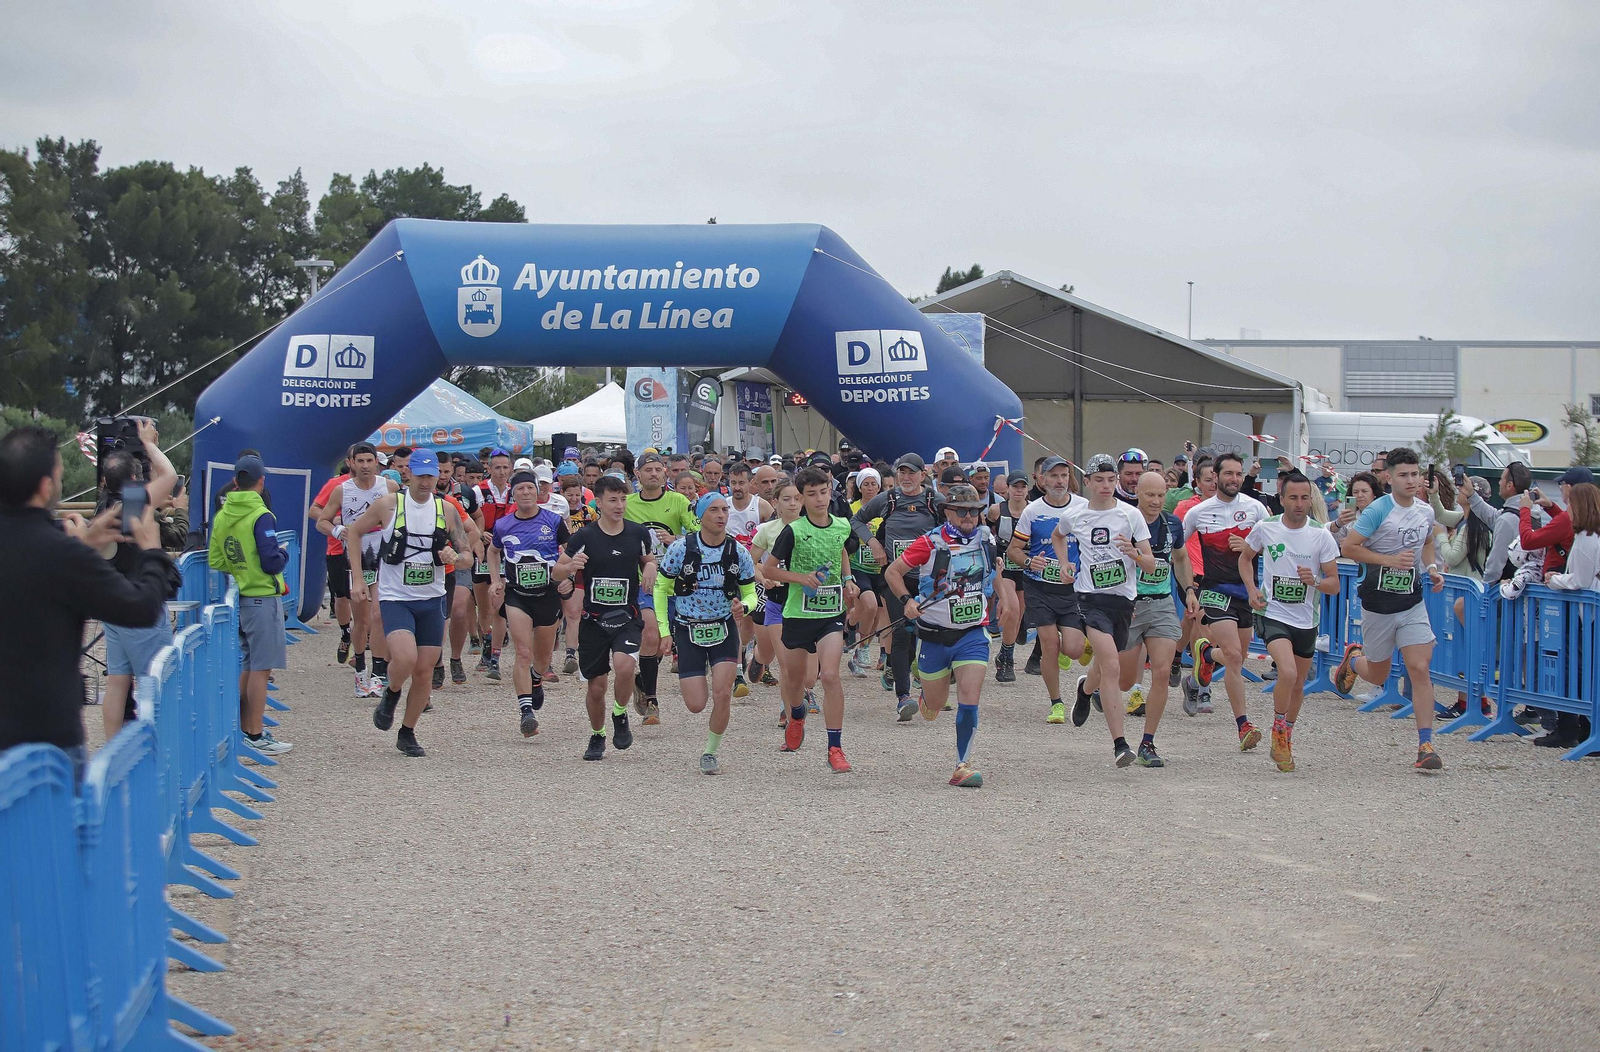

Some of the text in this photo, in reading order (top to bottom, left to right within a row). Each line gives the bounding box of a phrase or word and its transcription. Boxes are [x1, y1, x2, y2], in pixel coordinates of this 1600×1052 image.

[513, 261, 760, 298] Ayuntamiento
[541, 301, 734, 330] de La Línea
[295, 344, 318, 368] D
[847, 341, 871, 366] D
[282, 378, 356, 389] DELEGACIÓN DE
[838, 374, 913, 385] DELEGACIÓN DE
[281, 392, 371, 408] DEPORTES
[840, 386, 931, 403] DEPORTES
[408, 570, 433, 580] 449
[521, 571, 544, 581] 267
[1046, 567, 1060, 577] 36
[1096, 569, 1122, 582] 374
[1386, 575, 1410, 586] 270
[597, 588, 623, 597] 454
[1202, 590, 1225, 602] 249
[1276, 586, 1304, 596] 326
[809, 595, 836, 605] 451
[955, 604, 981, 617] 206
[695, 627, 721, 639] 367
